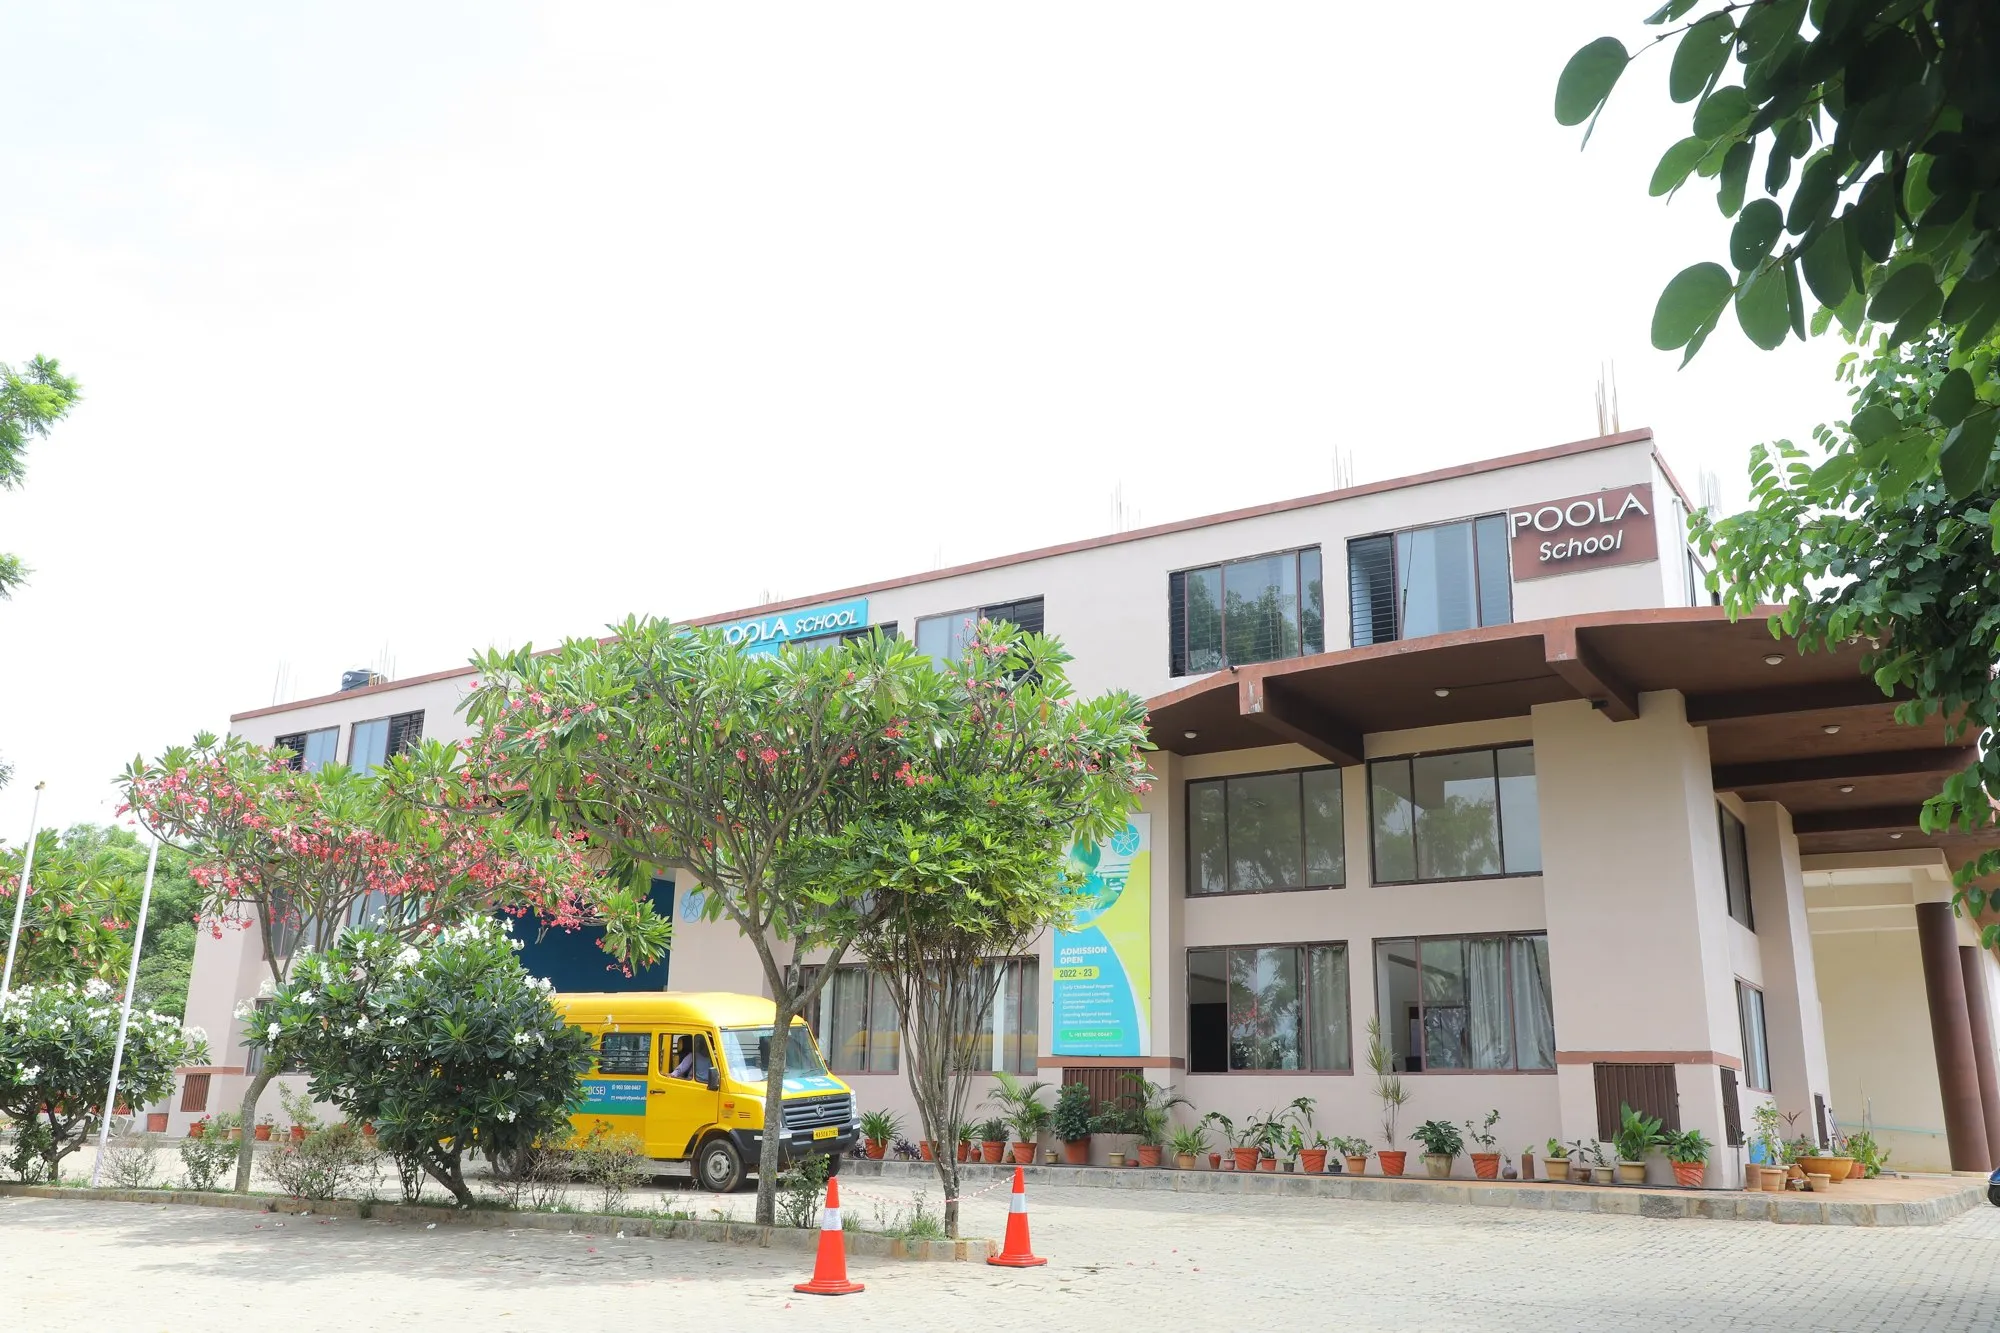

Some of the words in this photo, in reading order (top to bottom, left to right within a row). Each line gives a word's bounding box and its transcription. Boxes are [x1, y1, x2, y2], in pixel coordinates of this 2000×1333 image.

[1510, 492, 1650, 538] POOLA
[1539, 529, 1624, 562] School
[722, 617, 790, 647] OOLA
[795, 609, 858, 635] SCHOOL
[1060, 946, 1107, 955] ADMISSION
[1060, 956, 1083, 964] OPEN
[1060, 969, 1077, 978] 2022
[1083, 968, 1093, 977] 23
